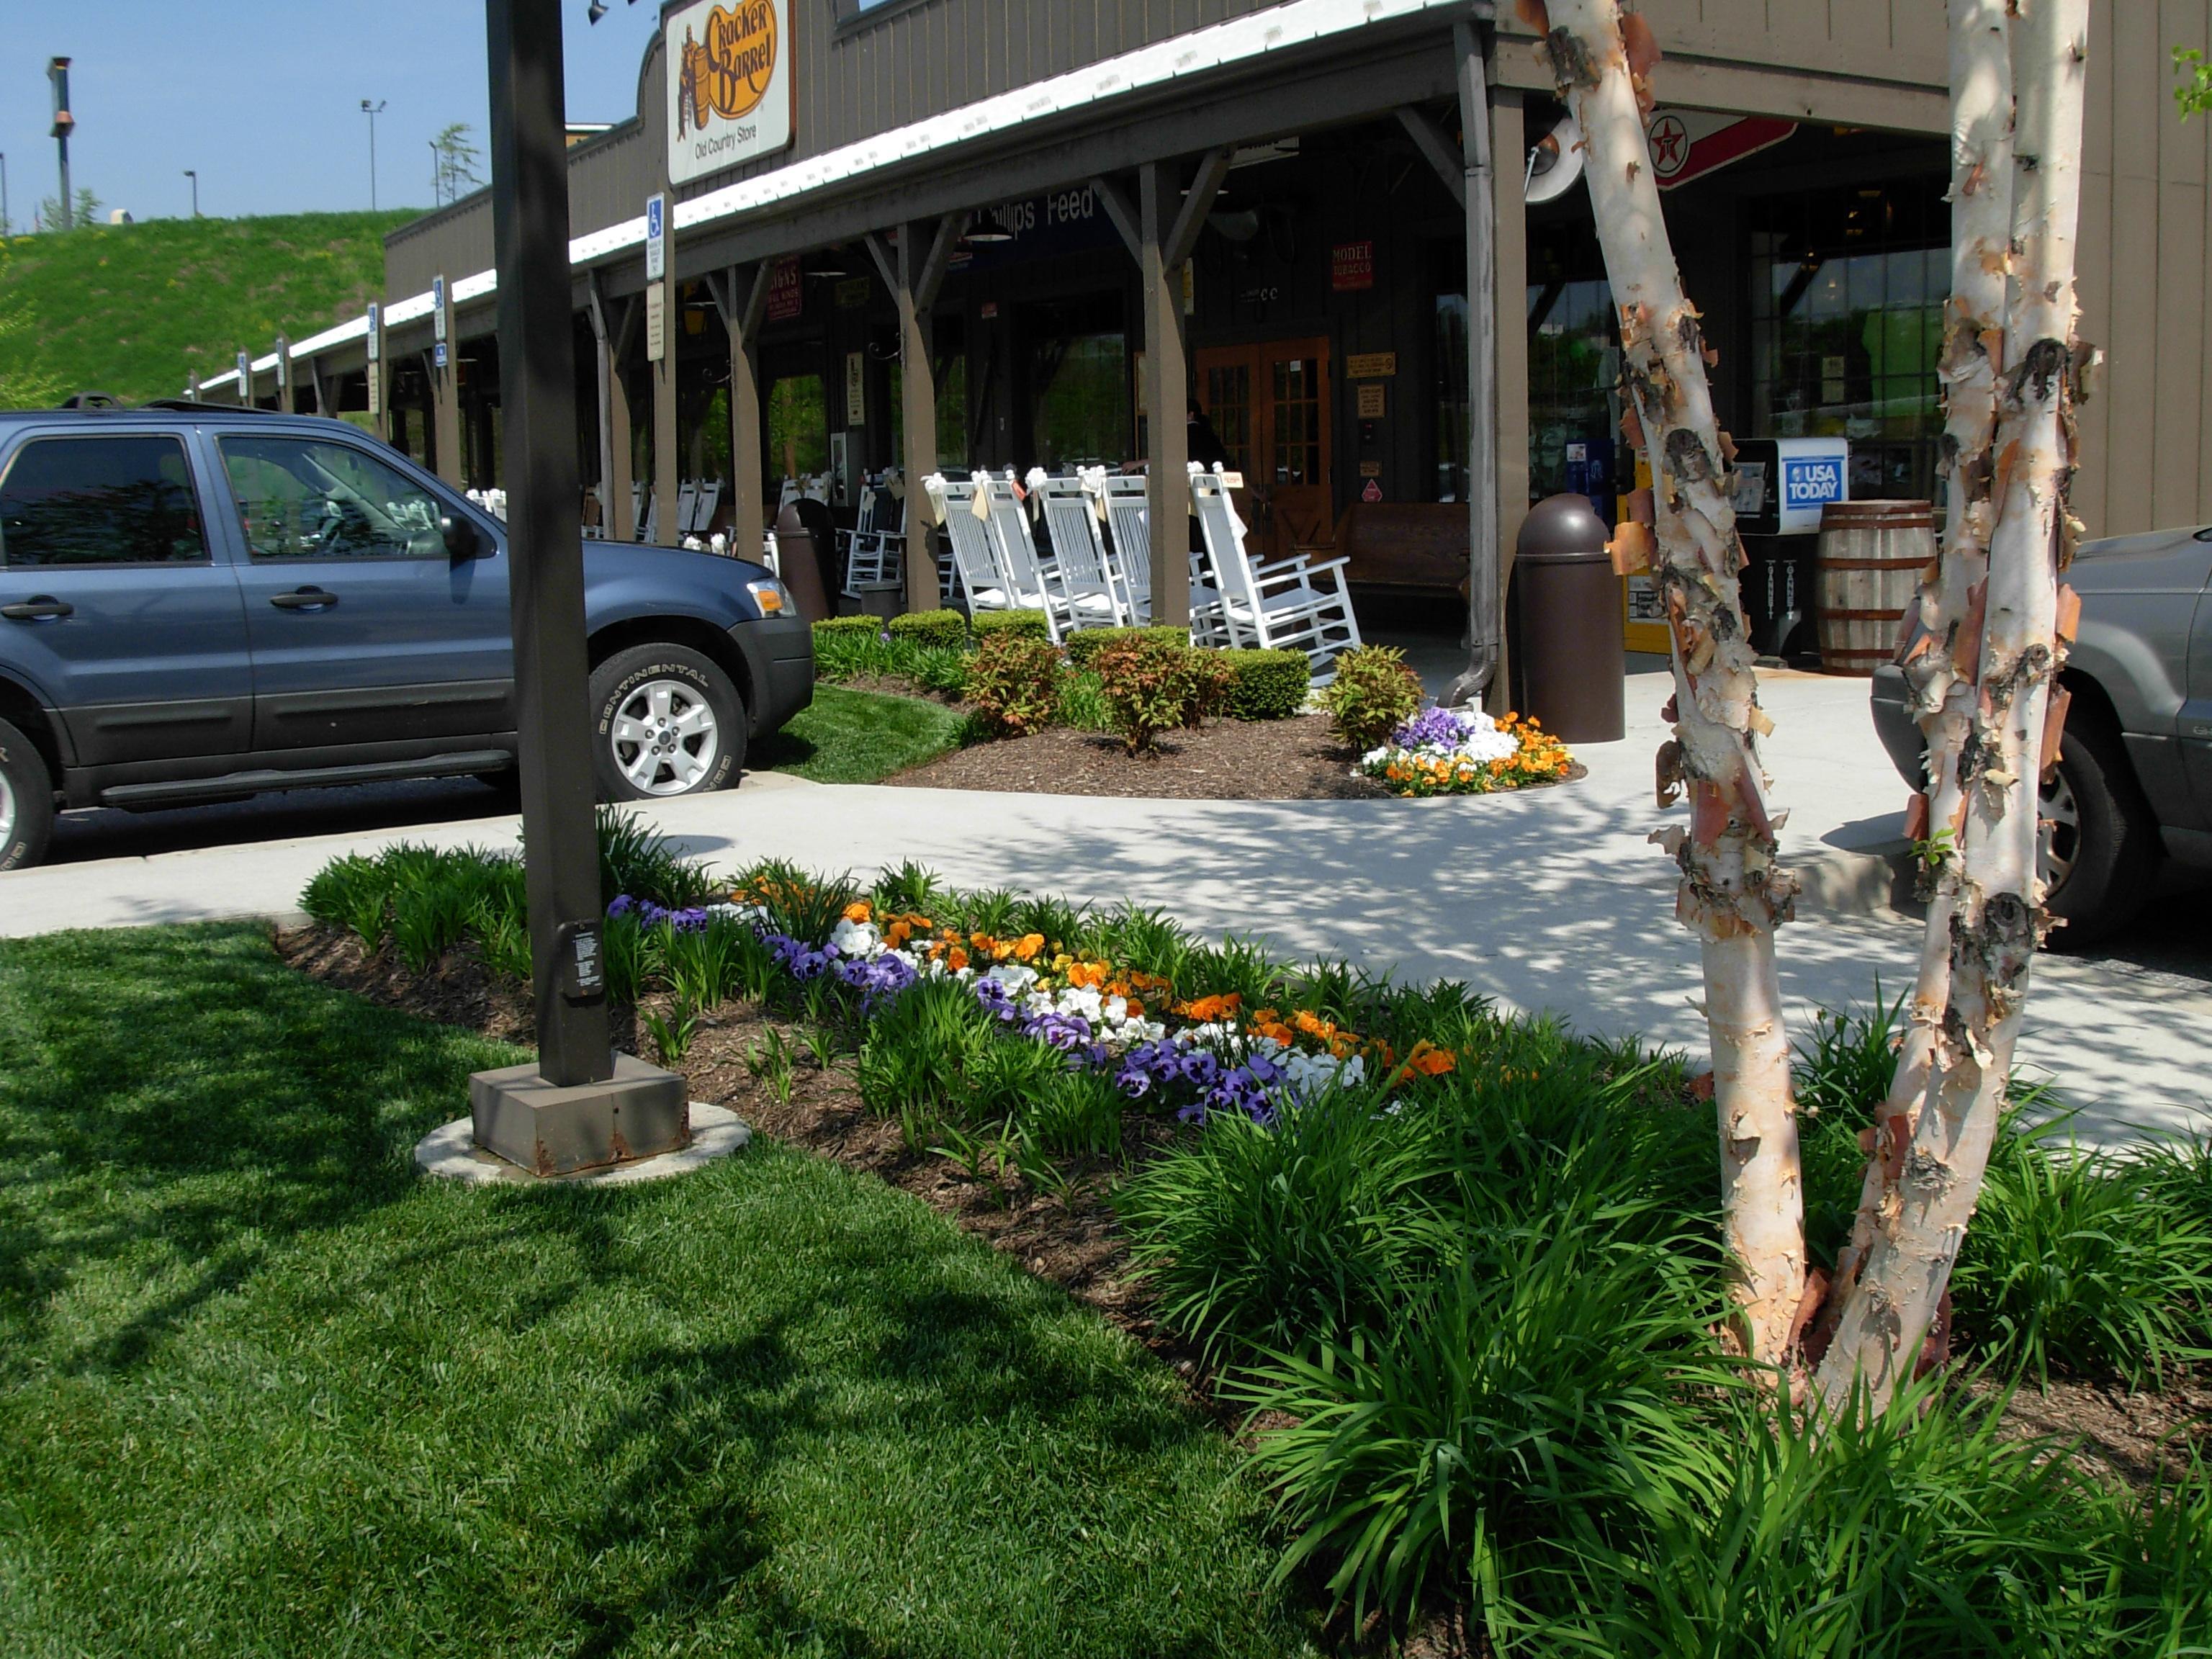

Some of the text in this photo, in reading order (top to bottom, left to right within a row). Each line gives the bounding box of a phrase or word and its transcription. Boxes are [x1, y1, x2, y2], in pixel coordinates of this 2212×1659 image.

[706, 2, 768, 73] Cracker
[719, 32, 771, 114] Barrel
[695, 124, 757, 159] Old Country Store
[977, 184, 1094, 241] hillips Feed
[1331, 245, 1372, 263] MODEL
[1789, 481, 1838, 500] TODAY
[1805, 464, 1837, 482] USA
[598, 663, 709, 735] CONTINENTAL
